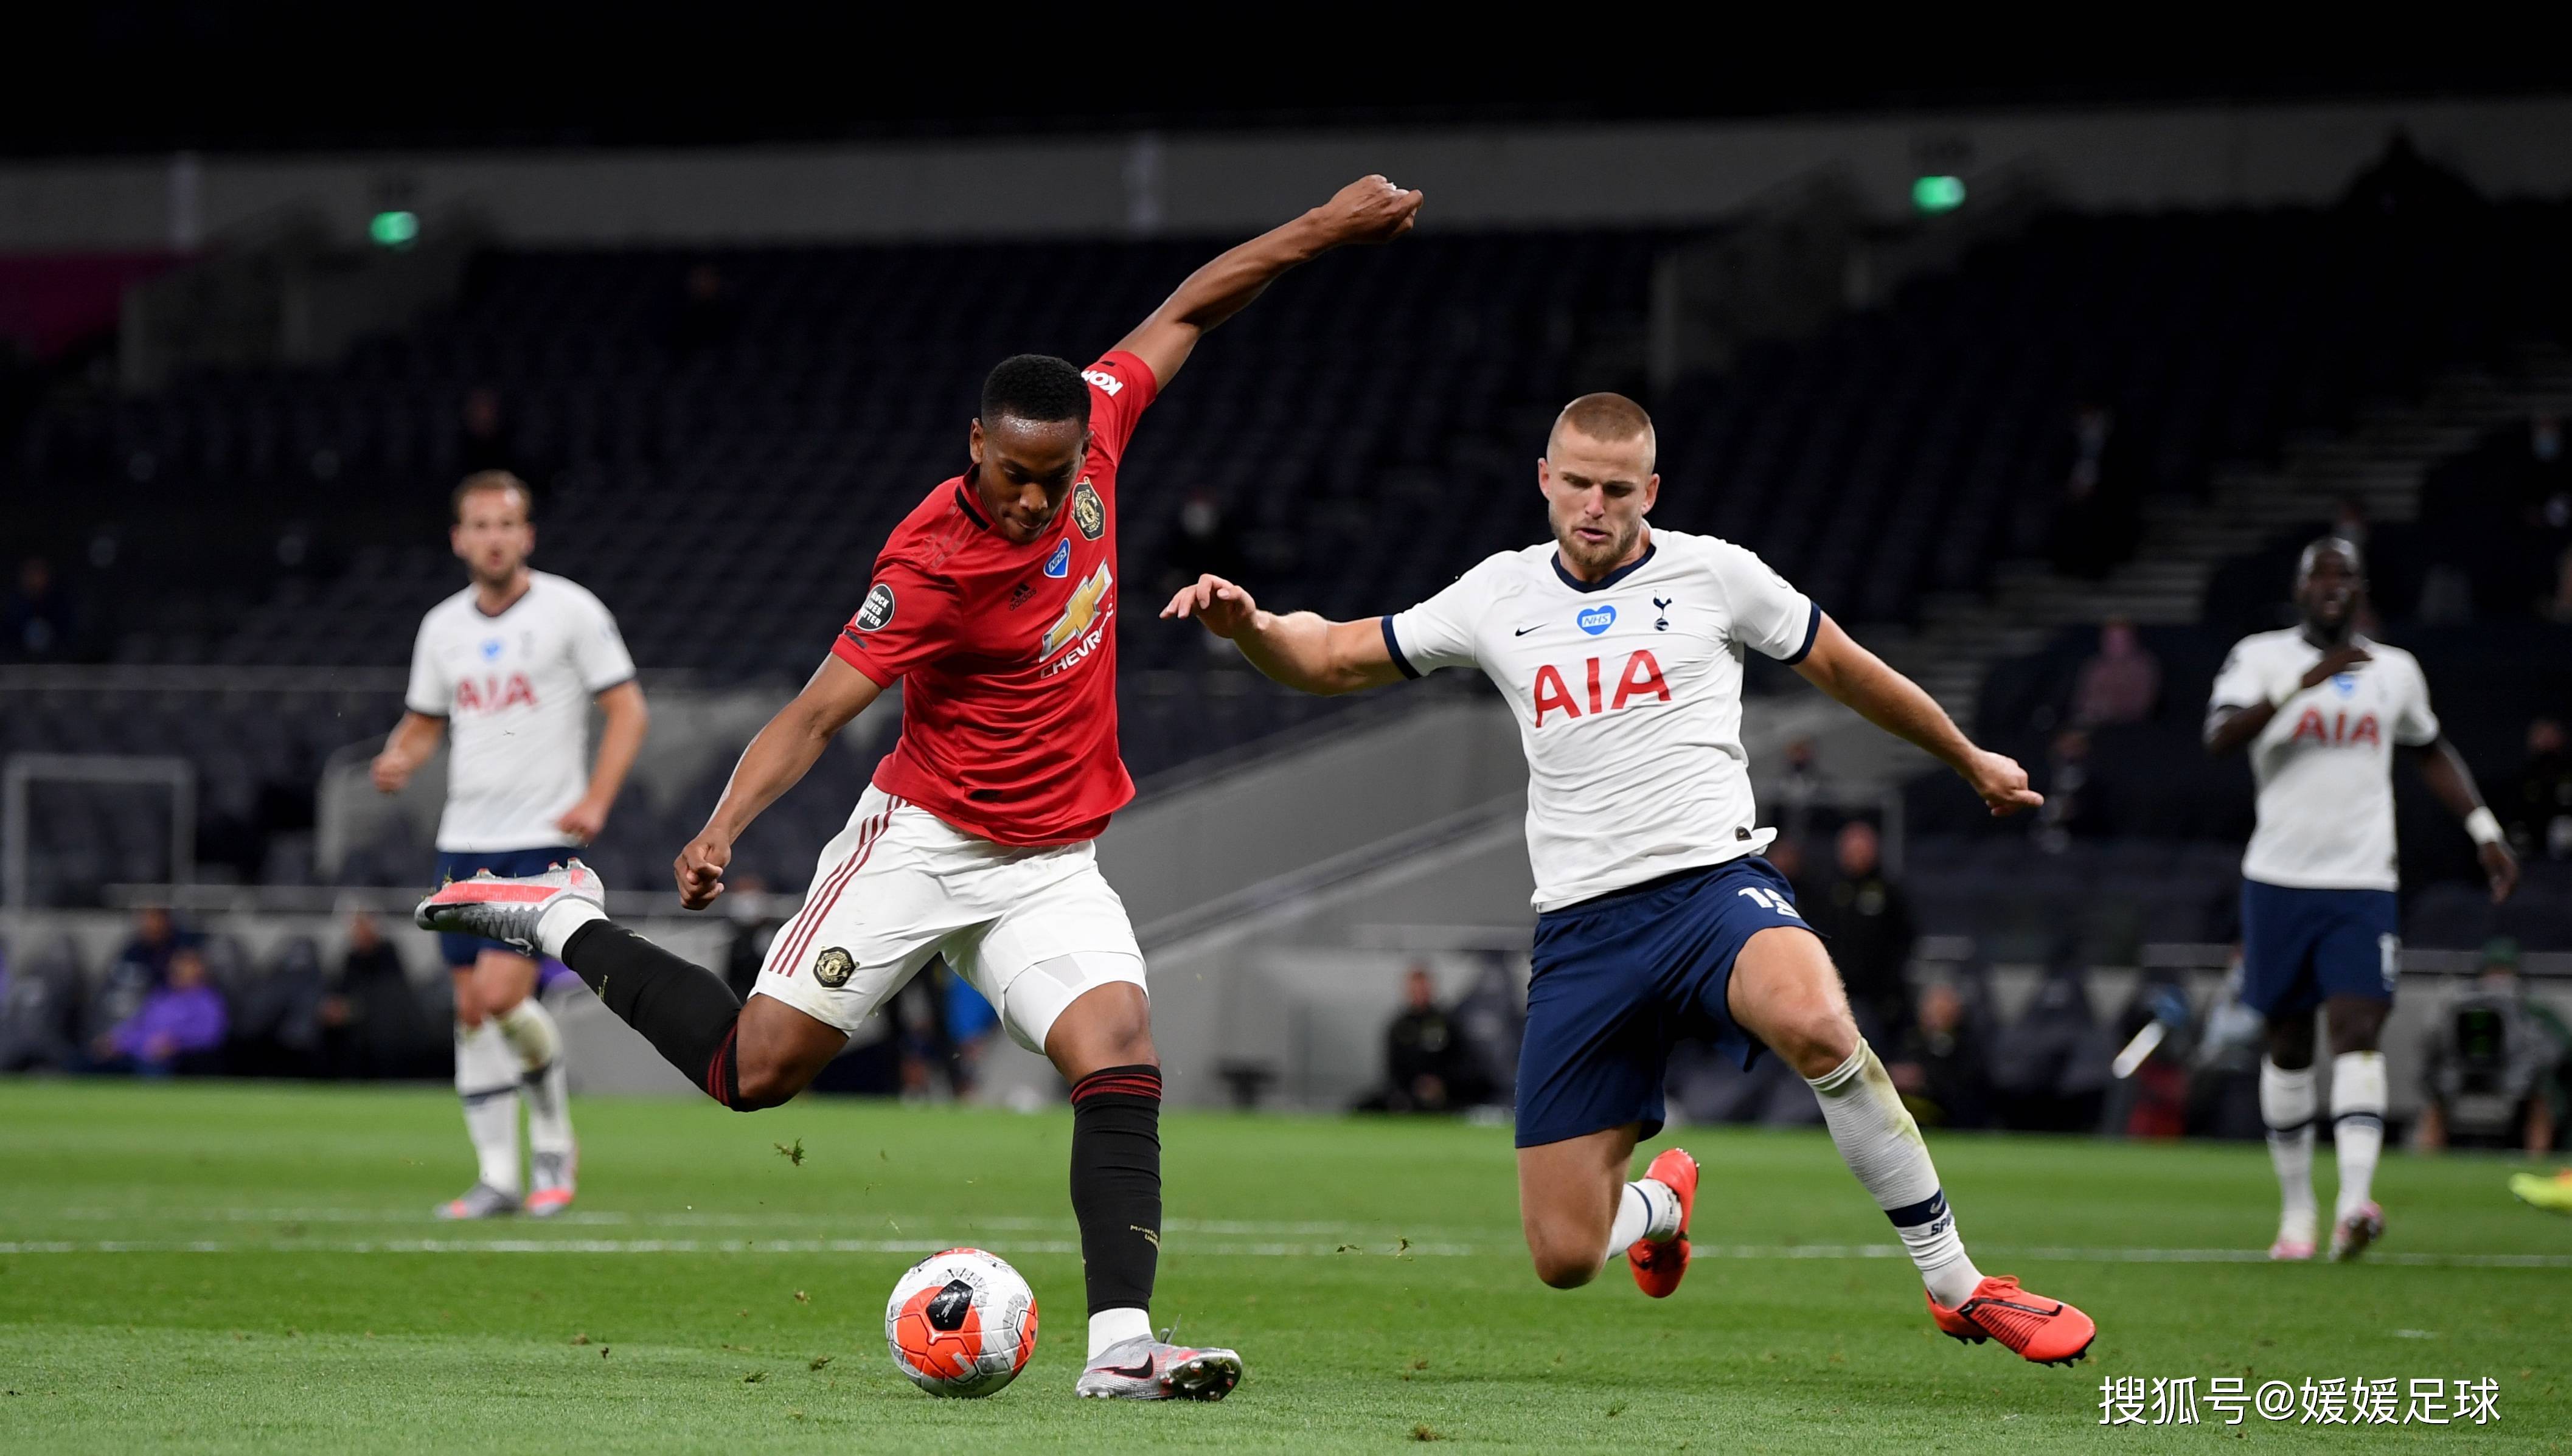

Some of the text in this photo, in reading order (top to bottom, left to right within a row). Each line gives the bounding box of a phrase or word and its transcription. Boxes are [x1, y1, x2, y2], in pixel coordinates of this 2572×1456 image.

[1050, 549, 1065, 570] NHS
[1009, 587, 1037, 611] adidas
[1584, 614, 1608, 625] NHS
[456, 672, 538, 713] AIA
[1534, 650, 1672, 729] AIA
[2292, 705, 2381, 747] AIA
